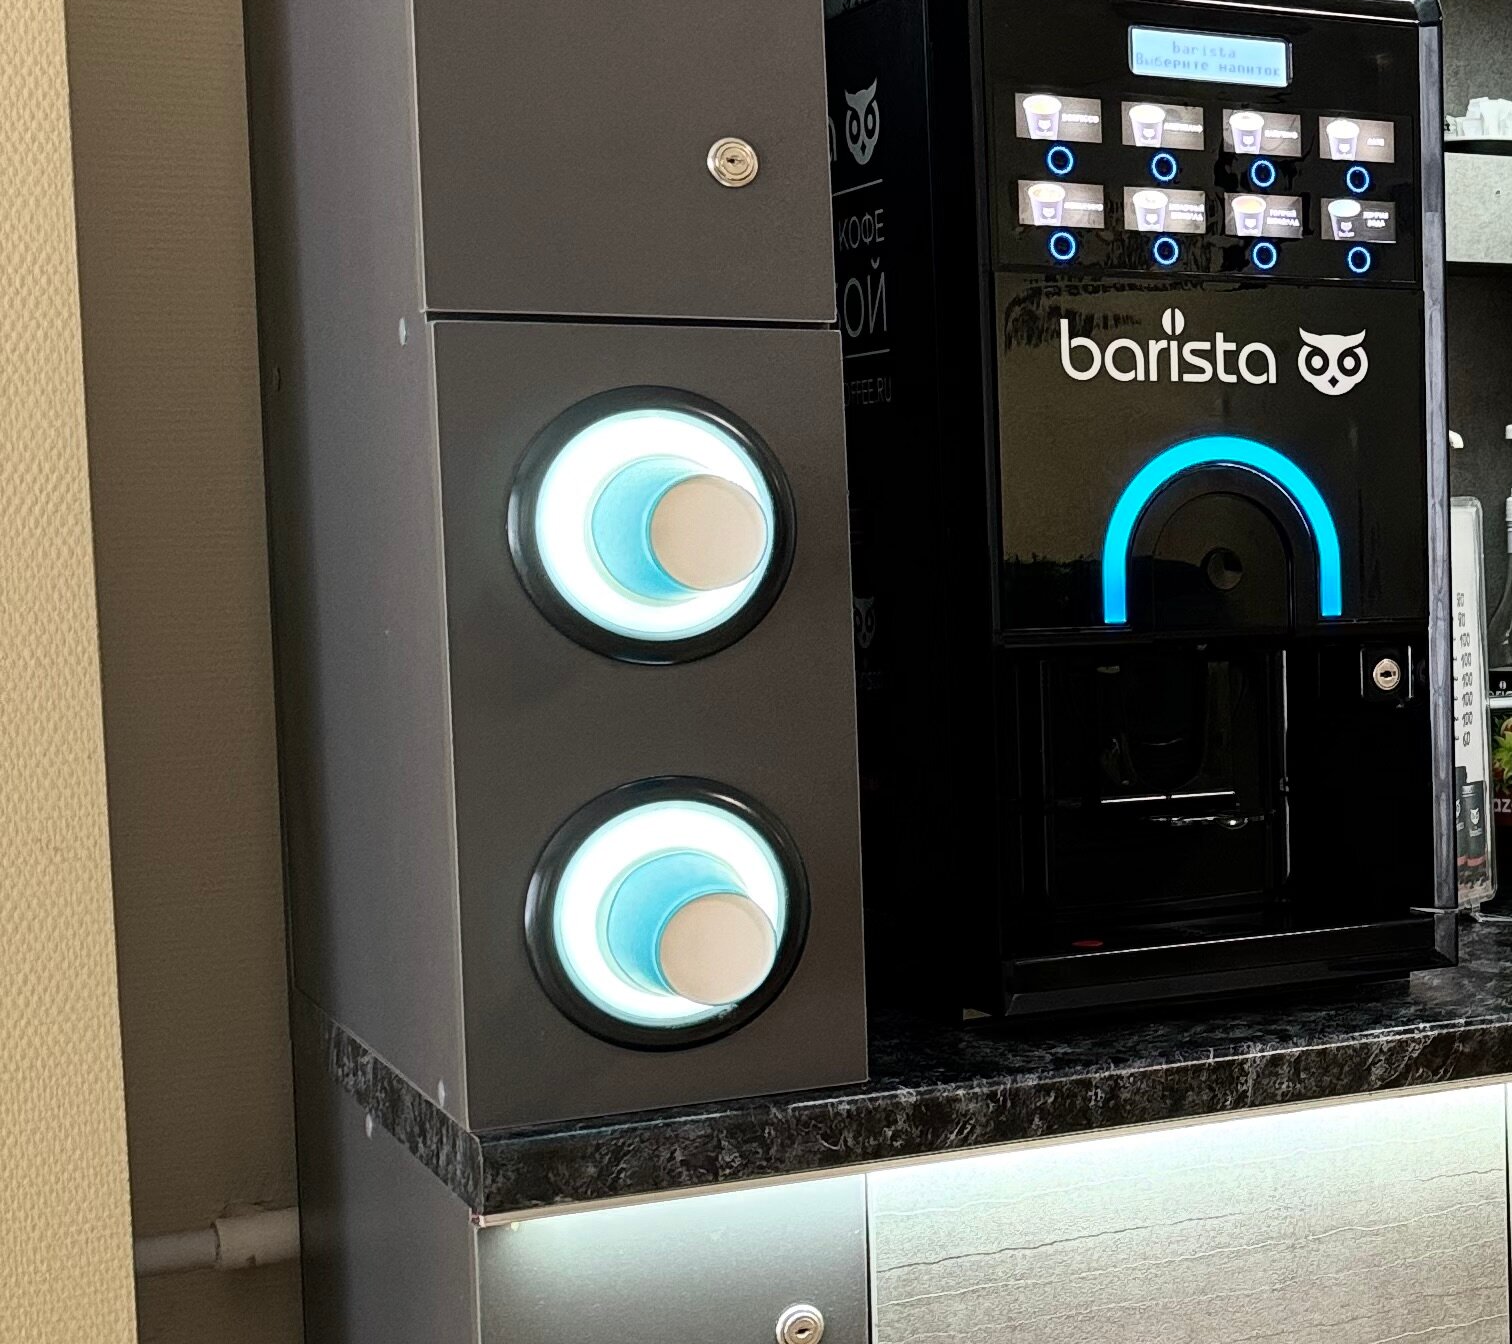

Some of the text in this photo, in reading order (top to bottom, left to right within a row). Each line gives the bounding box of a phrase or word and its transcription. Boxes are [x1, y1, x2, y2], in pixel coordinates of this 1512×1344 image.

[1136, 52, 1280, 77] Выберите напиток
[1172, 40, 1237, 59] barista
[838, 209, 885, 251] КОФЕ
[838, 256, 888, 339] ОЙ
[1059, 307, 1277, 385] barista
